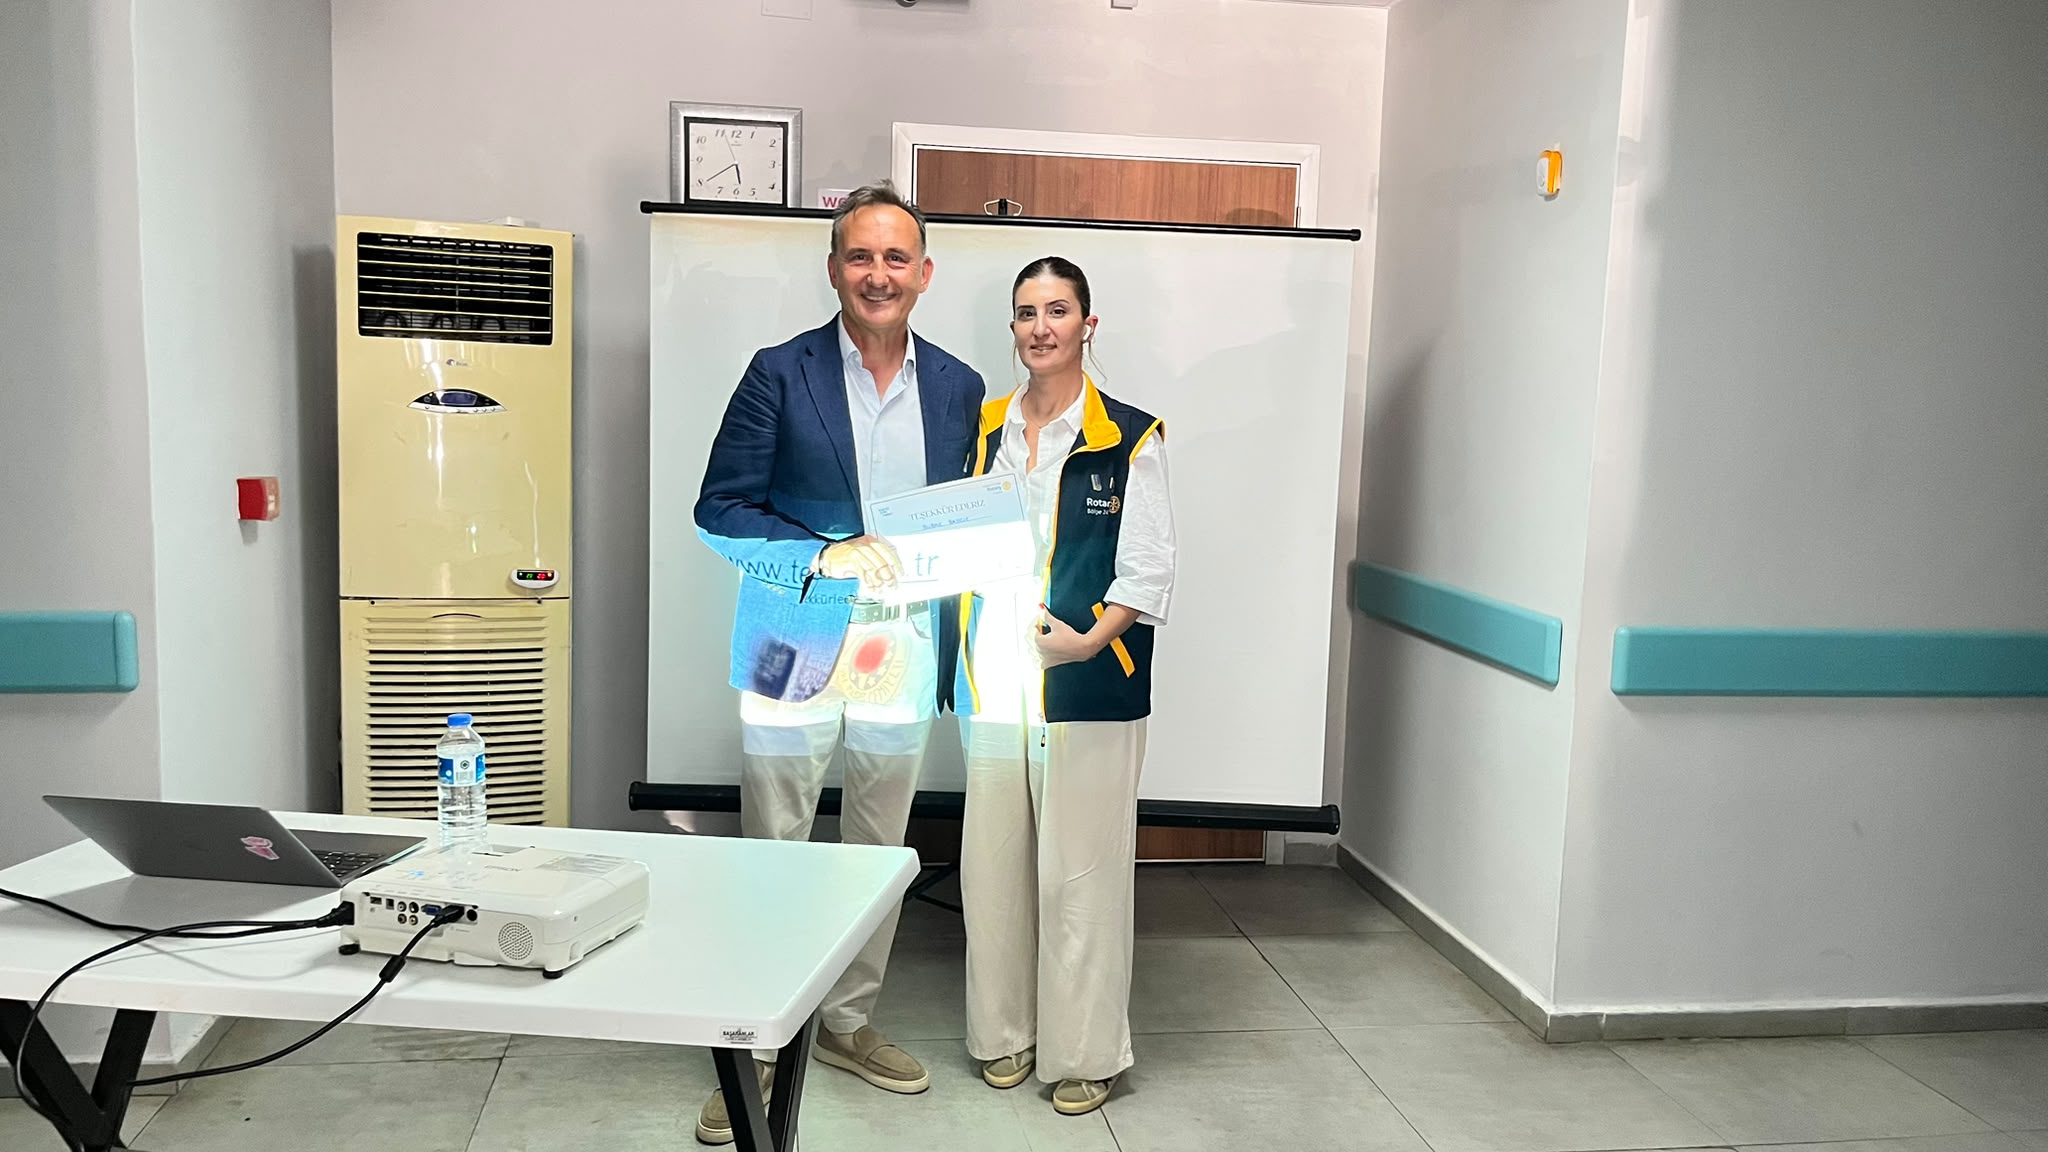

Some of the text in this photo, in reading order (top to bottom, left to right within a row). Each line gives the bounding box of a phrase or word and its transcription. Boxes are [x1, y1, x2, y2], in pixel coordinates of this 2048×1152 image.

[715, 129, 726, 137] 11
[731, 130, 742, 138] 12
[750, 131, 755, 139] 1
[696, 136, 707, 144] 10
[769, 139, 776, 147] 2
[696, 156, 703, 164] 9
[768, 160, 776, 169] 3
[717, 186, 724, 194] 7
[733, 187, 740, 195] 6
[748, 188, 756, 196] 5
[1086, 497, 1112, 508] Rotar
